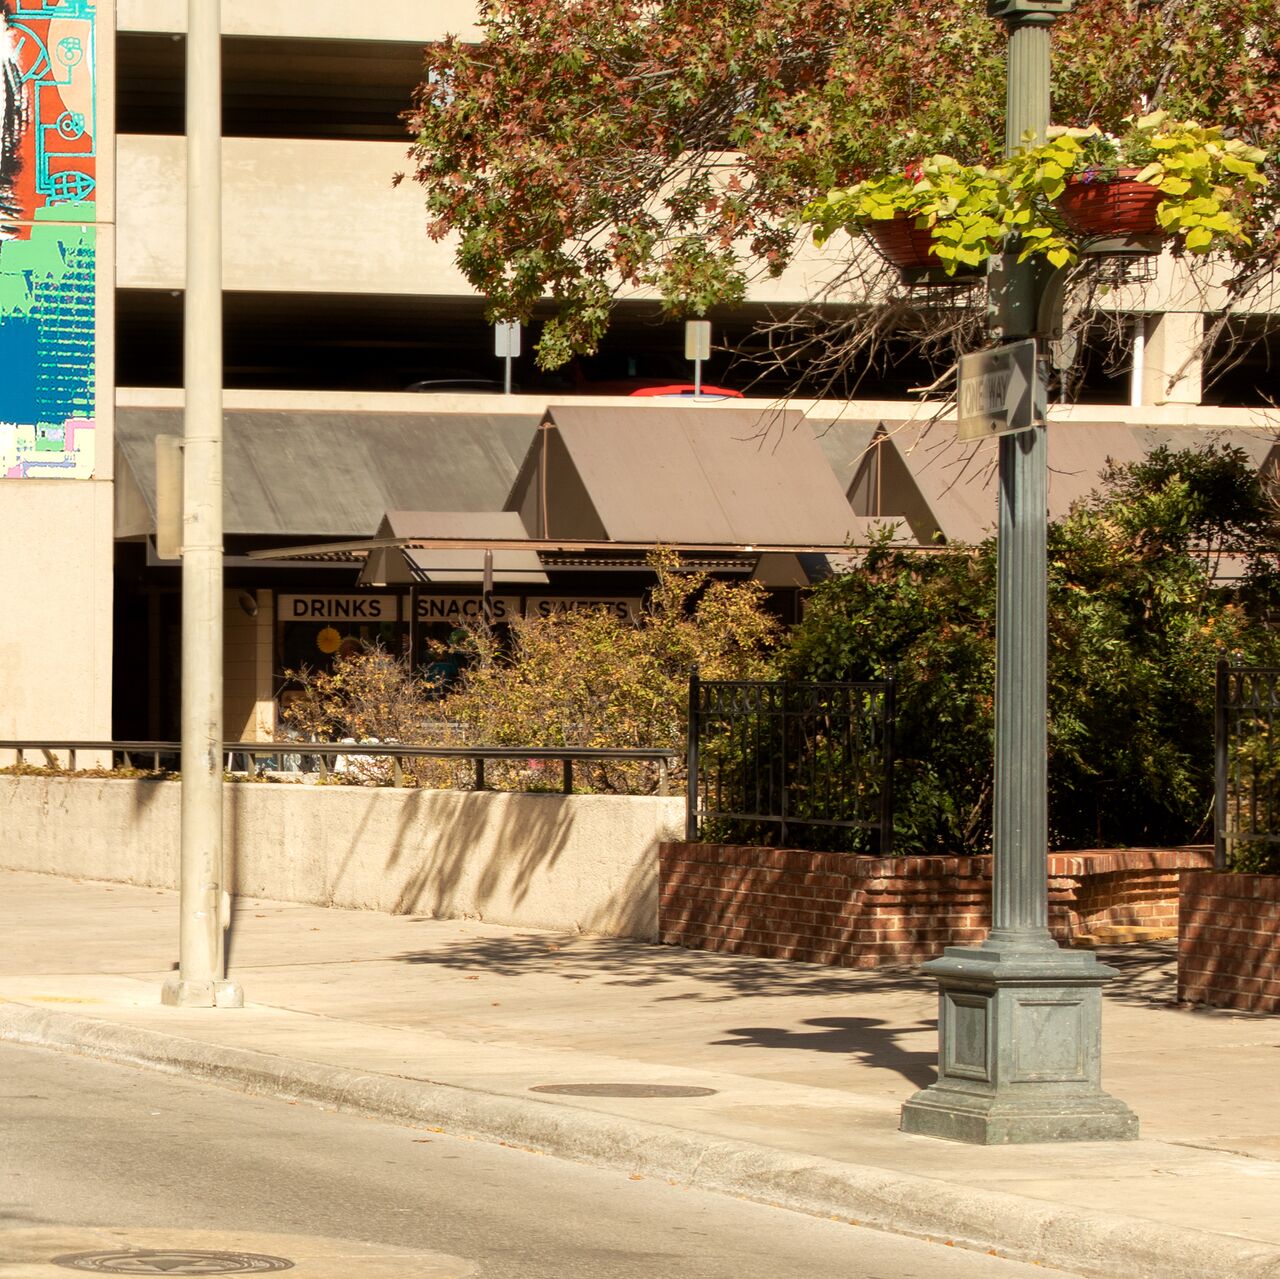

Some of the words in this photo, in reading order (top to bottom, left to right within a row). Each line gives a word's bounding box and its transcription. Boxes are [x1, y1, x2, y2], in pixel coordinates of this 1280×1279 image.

[965, 377, 985, 415] ONE
[989, 370, 1011, 410] WAY
[293, 599, 382, 617] DRINKS
